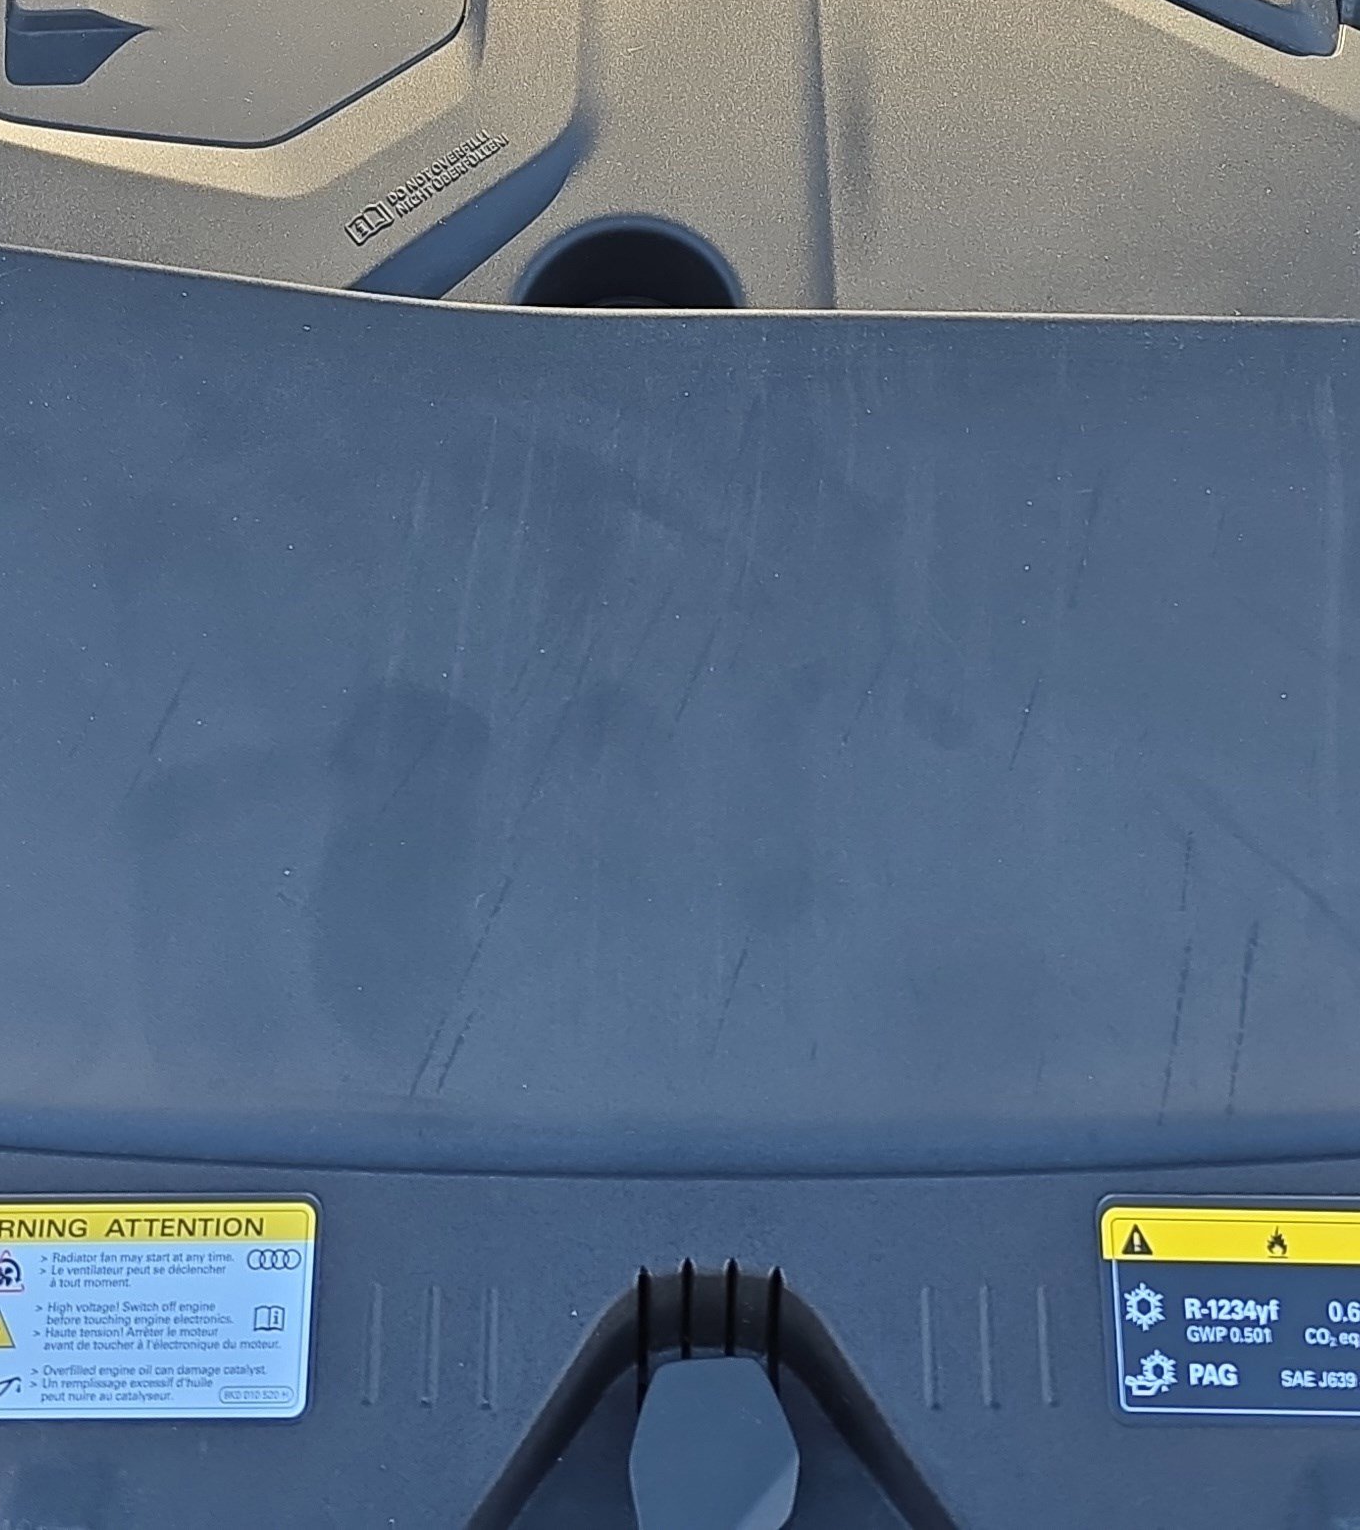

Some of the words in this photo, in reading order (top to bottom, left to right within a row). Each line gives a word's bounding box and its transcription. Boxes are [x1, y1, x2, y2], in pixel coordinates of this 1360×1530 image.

[386, 185, 407, 207] DO
[405, 167, 434, 195] NOT
[105, 1217, 265, 1238] ATTENTION
[52, 1252, 97, 1264] Radiator
[100, 1252, 118, 1263] fan
[120, 1253, 142, 1265] may
[146, 1253, 171, 1263] start
[173, 1253, 184, 1263] at
[186, 1254, 205, 1265] any
[208, 1252, 235, 1262] time.
[51, 1265, 65, 1275] Le
[67, 1264, 124, 1275] ventilateur
[126, 1265, 151, 1277] peut
[153, 1267, 165, 1275] se
[168, 1264, 226, 1275] déclencher
[59, 1278, 81, 1289] tout
[48, 1302, 73, 1315] High
[123, 1302, 159, 1313] Switch
[162, 1301, 177, 1313] off
[179, 1302, 216, 1315] engine
[1184, 1297, 1280, 1323] R-1234yf
[46, 1315, 81, 1326] before
[83, 1315, 131, 1327] touching
[134, 1315, 171, 1327] engine
[173, 1315, 234, 1325] electronics.
[45, 1327, 77, 1338] Haute
[167, 1327, 177, 1337] le
[179, 1328, 218, 1337] moteur
[1187, 1327, 1228, 1344] GWP
[1229, 1327, 1273, 1344] 0.501
[1339, 1333, 1360, 1349] eq
[43, 1341, 73, 1351] avant
[77, 1340, 90, 1351] de
[93, 1340, 134, 1351] toucher
[223, 1339, 236, 1350] du
[43, 1365, 96, 1376] Overfilled
[98, 1366, 136, 1378] engine
[139, 1366, 152, 1376] oil
[155, 1367, 175, 1376] can
[177, 1365, 221, 1377] damage
[1189, 1363, 1239, 1386] PAG
[1280, 1370, 1315, 1387] SAE
[1319, 1370, 1357, 1388] J639
[42, 1378, 58, 1389] Un
[61, 1378, 127, 1391] remplissage
[130, 1378, 174, 1389] excessif
[41, 1392, 66, 1404] peut
[68, 1391, 96, 1402] nuire
[99, 1393, 113, 1402] au
